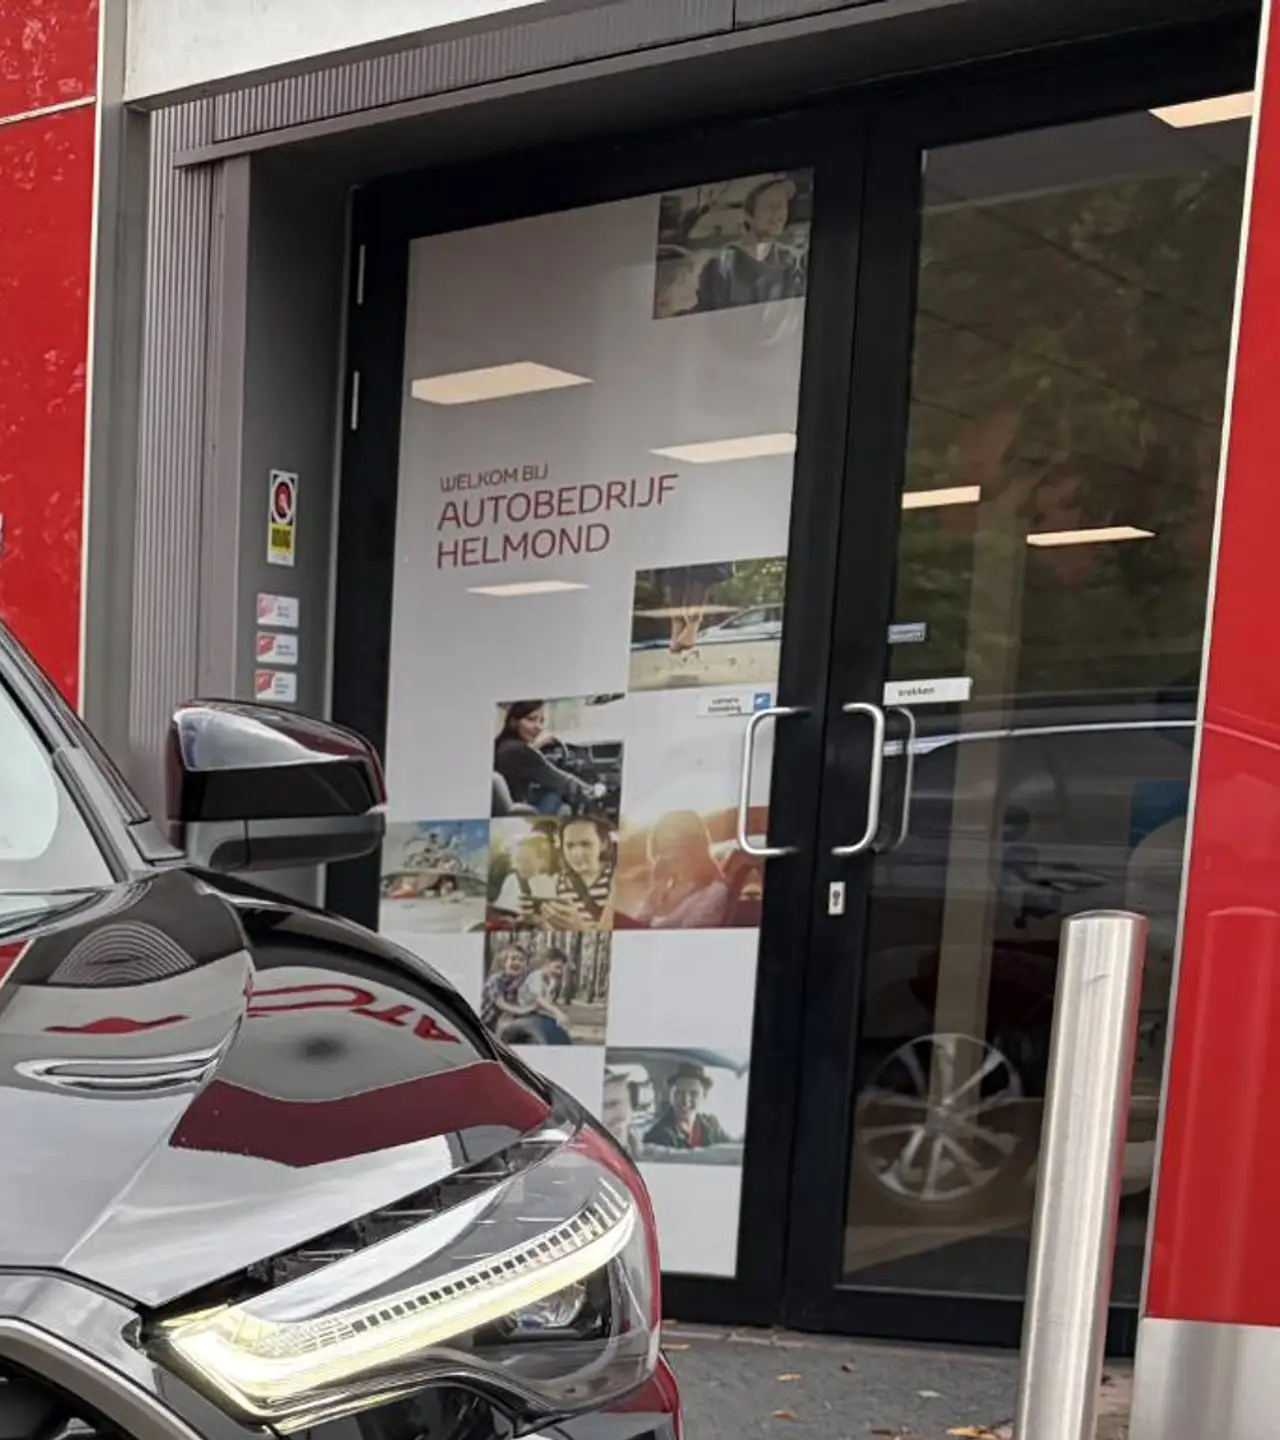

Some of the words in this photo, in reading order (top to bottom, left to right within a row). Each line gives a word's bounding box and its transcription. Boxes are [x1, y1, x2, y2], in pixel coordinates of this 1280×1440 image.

[440, 467, 518, 493] WELKOM
[522, 463, 549, 482] BIJ
[437, 474, 679, 531] AUTOBEDRIJF
[437, 523, 610, 569] HELMOND
